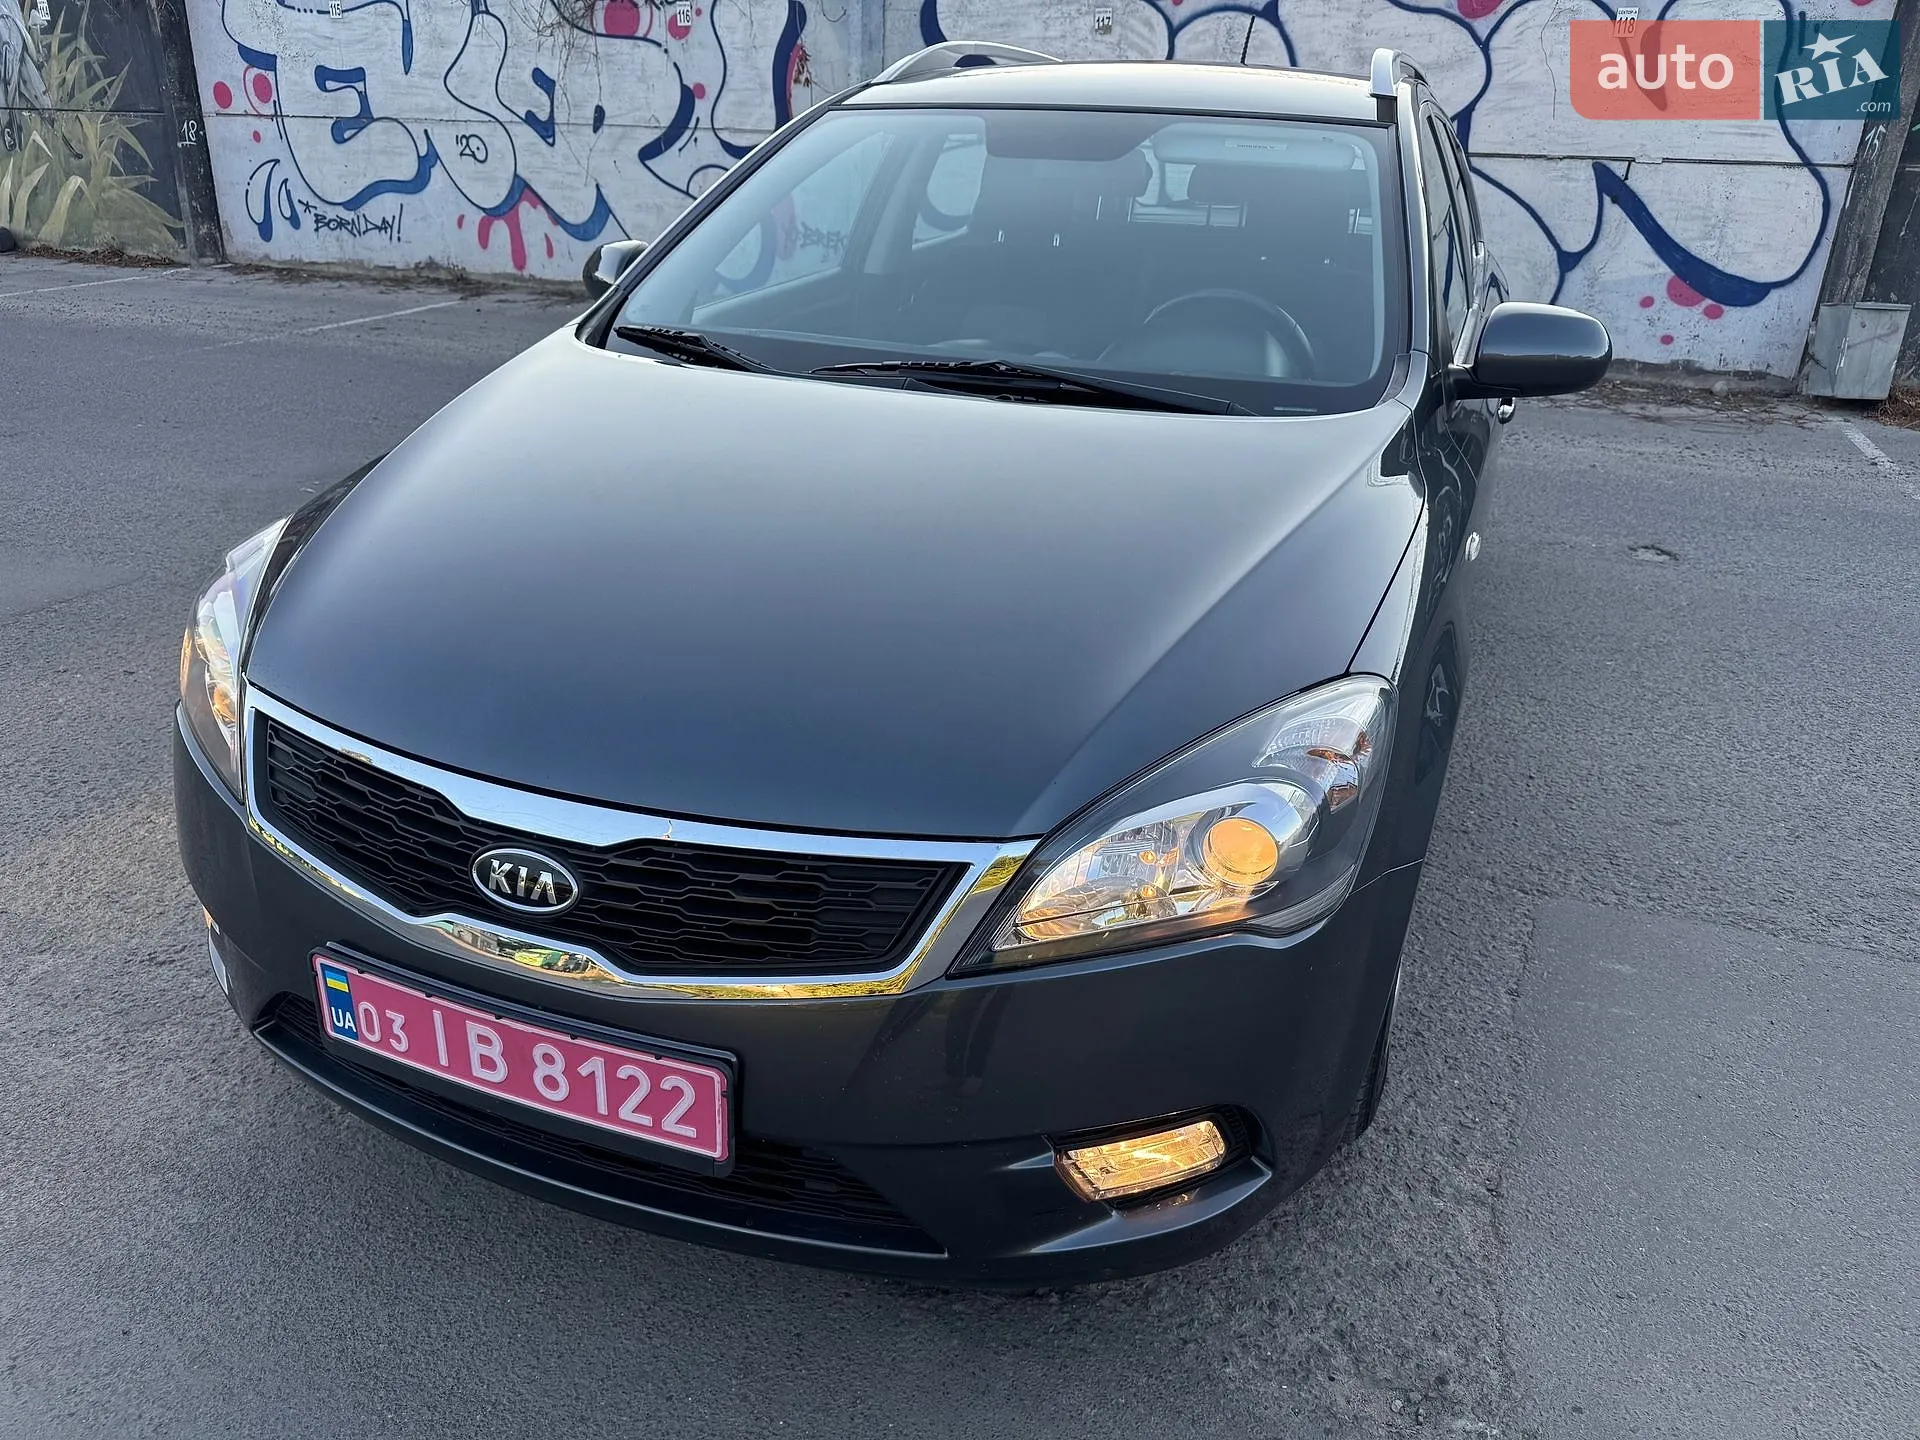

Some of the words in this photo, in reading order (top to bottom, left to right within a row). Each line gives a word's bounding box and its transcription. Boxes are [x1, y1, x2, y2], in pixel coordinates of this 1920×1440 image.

[330, 3, 341, 17] 115
[678, 9, 691, 23] 116
[1096, 16, 1111, 30] 117
[1616, 16, 1636, 34] 118
[180, 119, 197, 142] 18
[488, 859, 558, 905] KIA
[331, 1005, 357, 1033] UA
[358, 1001, 409, 1053] 03
[531, 1042, 697, 1139] 8122
